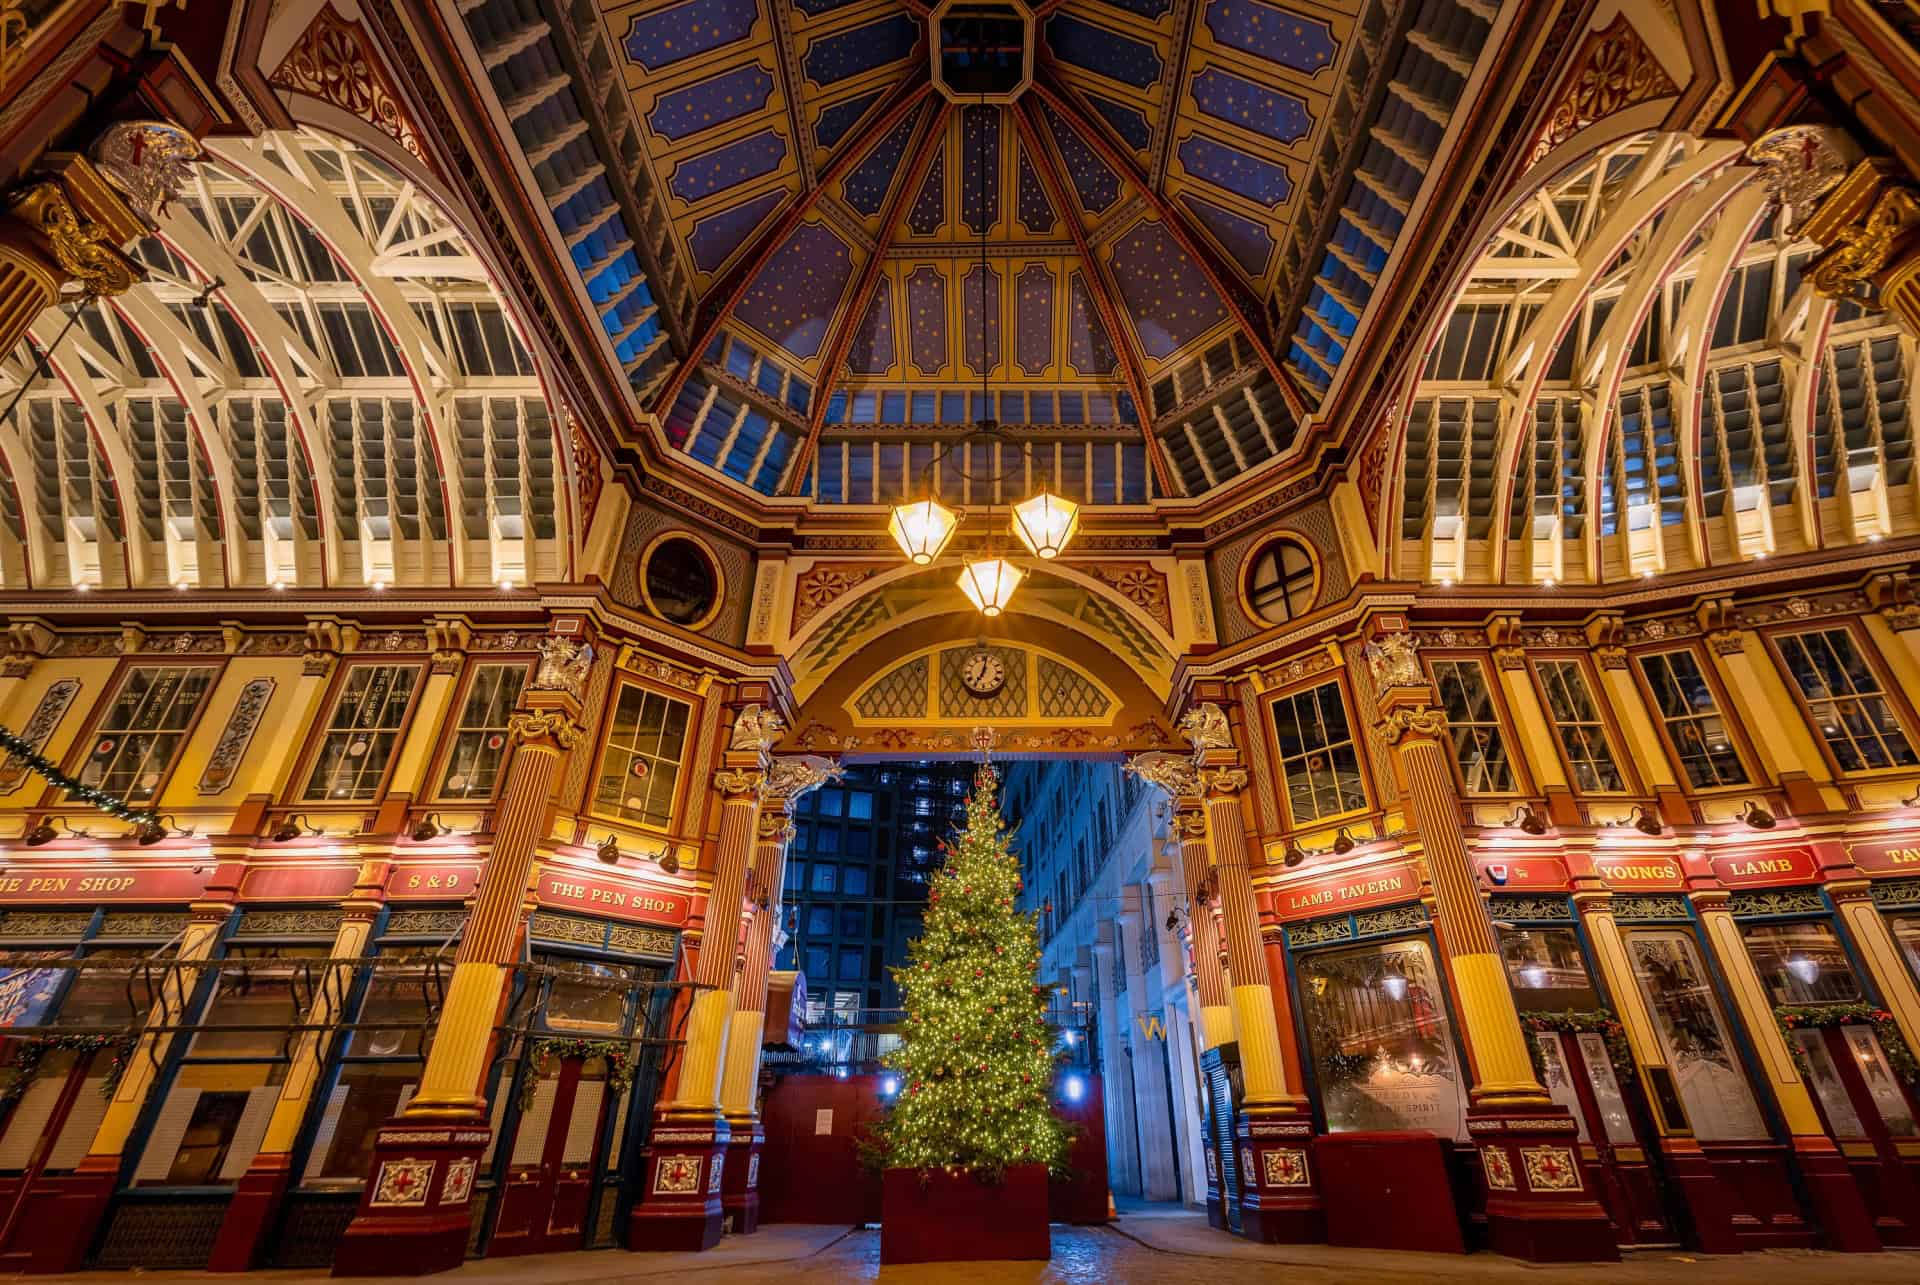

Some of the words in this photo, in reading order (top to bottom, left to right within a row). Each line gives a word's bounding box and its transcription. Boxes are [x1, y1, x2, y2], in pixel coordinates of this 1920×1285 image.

[1601, 866, 1677, 880] YOUNGS
[1730, 859, 1793, 876] LAMB
[27, 877, 71, 892] PEN
[77, 876, 136, 891] SHOP
[427, 873, 441, 888] &
[446, 873, 459, 888] 9
[551, 881, 585, 899] THE
[591, 888, 627, 905] PEN
[631, 895, 675, 913] SHOP
[1291, 891, 1334, 909] LAMB
[1338, 876, 1402, 900] TAVERN
